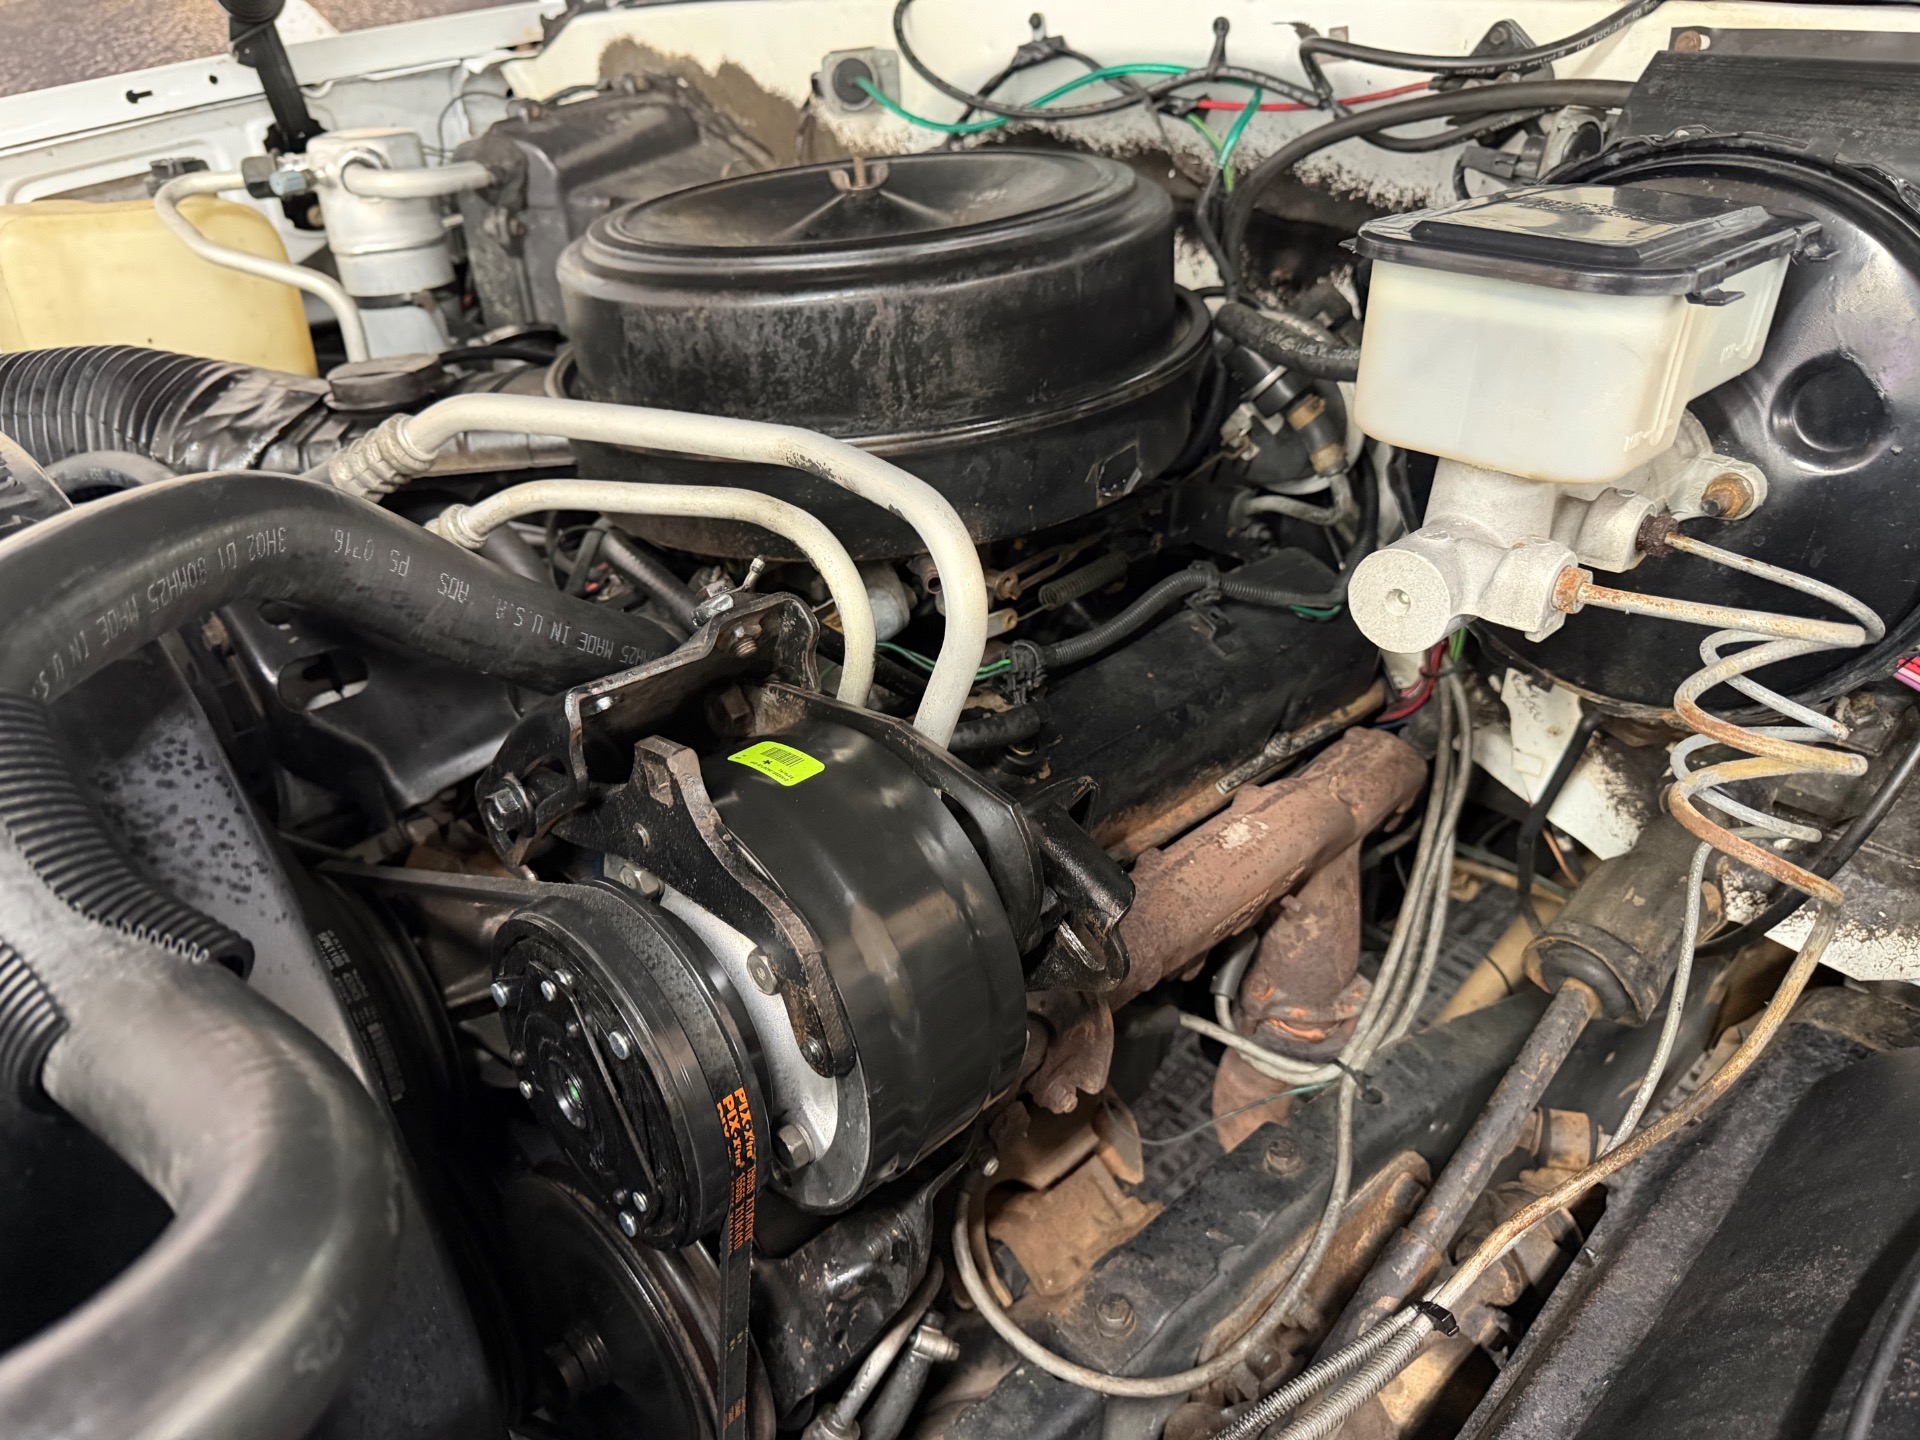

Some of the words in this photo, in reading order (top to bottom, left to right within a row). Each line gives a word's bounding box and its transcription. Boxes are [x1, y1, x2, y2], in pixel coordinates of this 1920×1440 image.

[96, 594, 140, 647] MADE
[550, 621, 571, 646] IN
[69, 630, 91, 668] IN
[577, 631, 615, 661] MADE
